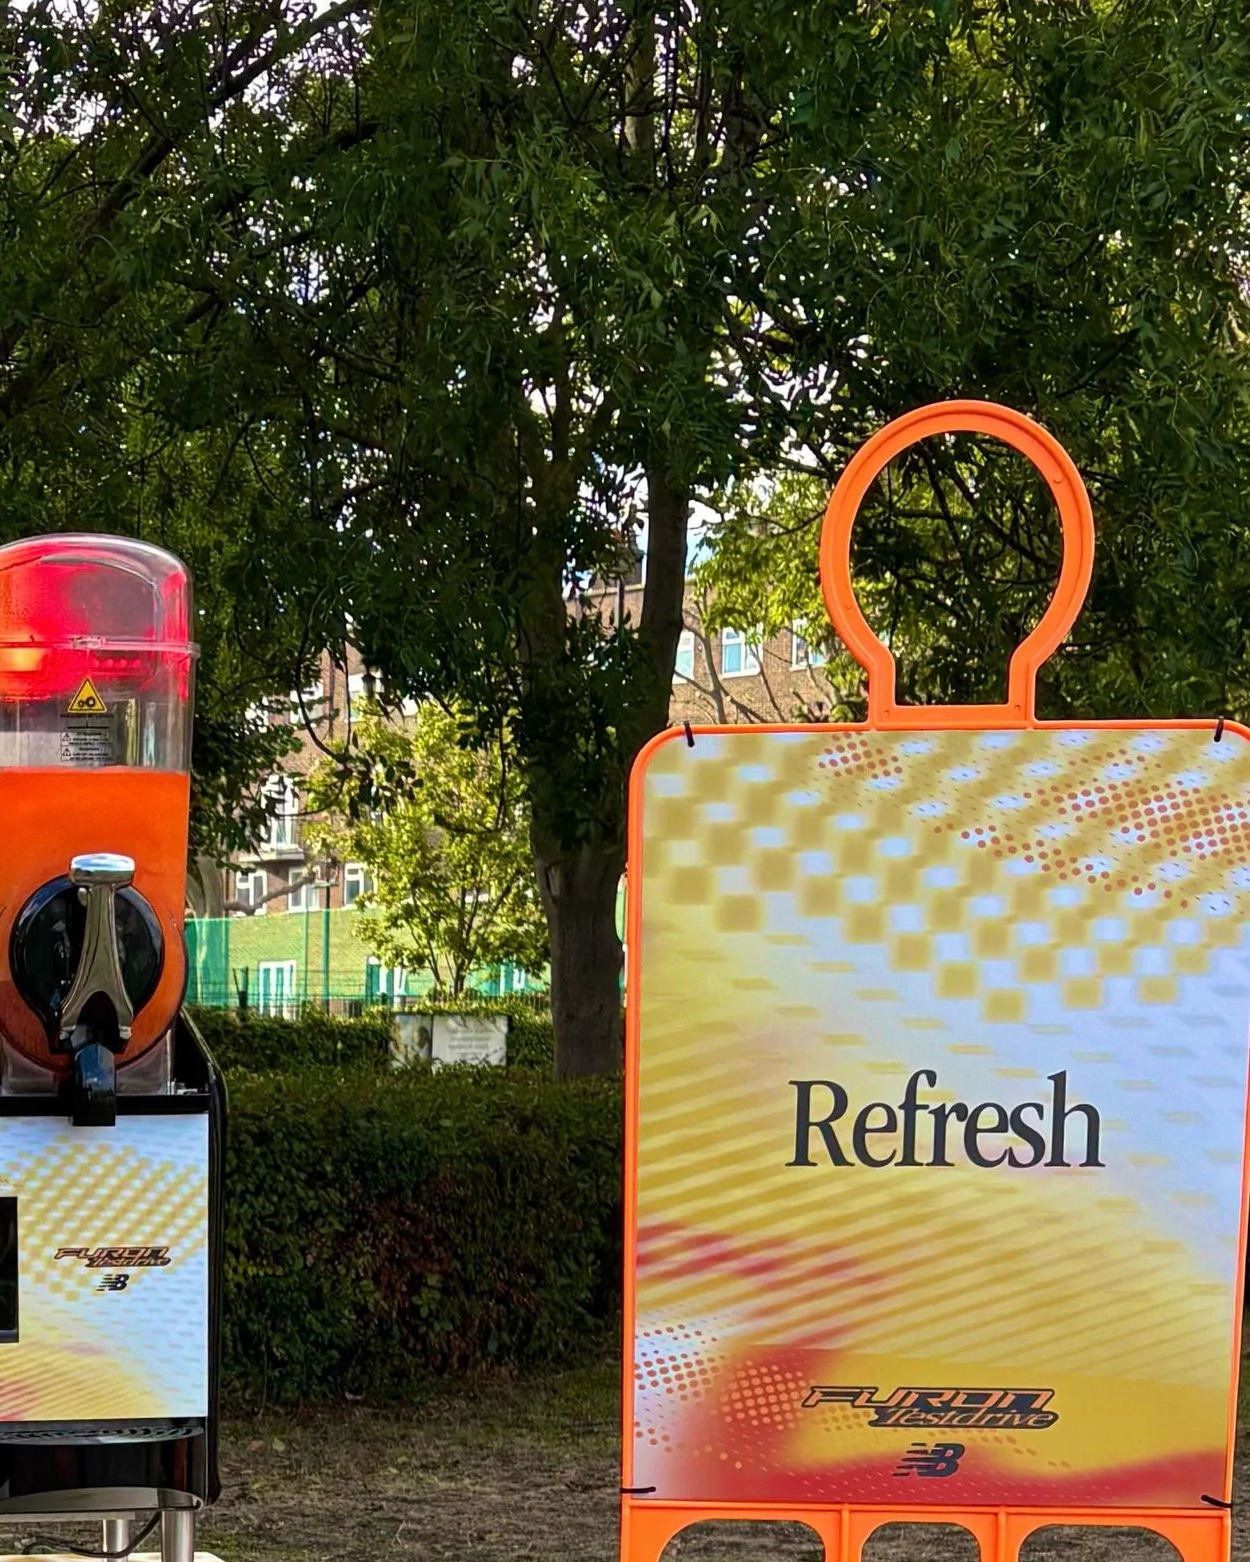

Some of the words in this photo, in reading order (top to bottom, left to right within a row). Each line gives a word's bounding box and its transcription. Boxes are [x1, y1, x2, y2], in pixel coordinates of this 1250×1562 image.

[784, 1069, 1106, 1168] Refresh
[54, 1246, 169, 1259] FURON
[801, 1386, 1055, 1408] FURON
[881, 1405, 1057, 1428] Testdrive
